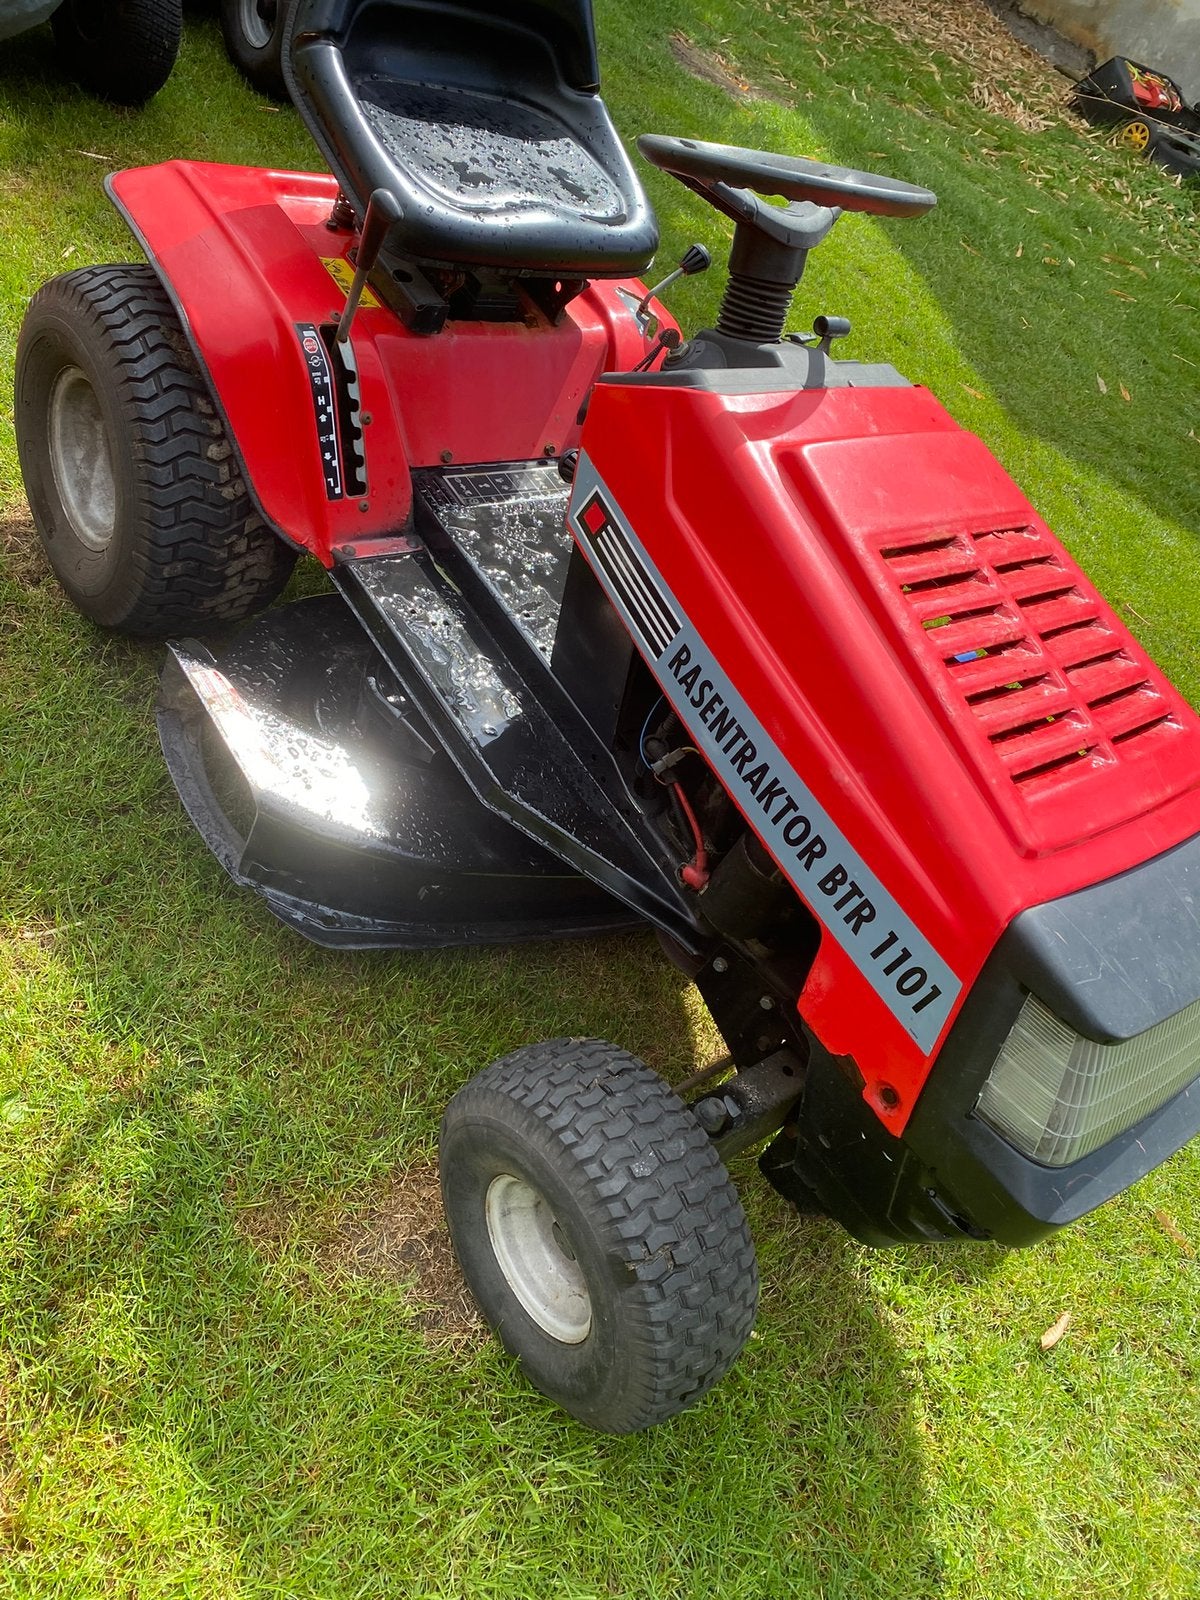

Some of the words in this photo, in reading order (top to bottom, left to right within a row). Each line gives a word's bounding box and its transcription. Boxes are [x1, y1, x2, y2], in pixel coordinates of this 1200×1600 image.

[667, 643, 828, 872] RASENTRAKTOR
[816, 862, 877, 936] BTR
[869, 930, 944, 1014] 1101
